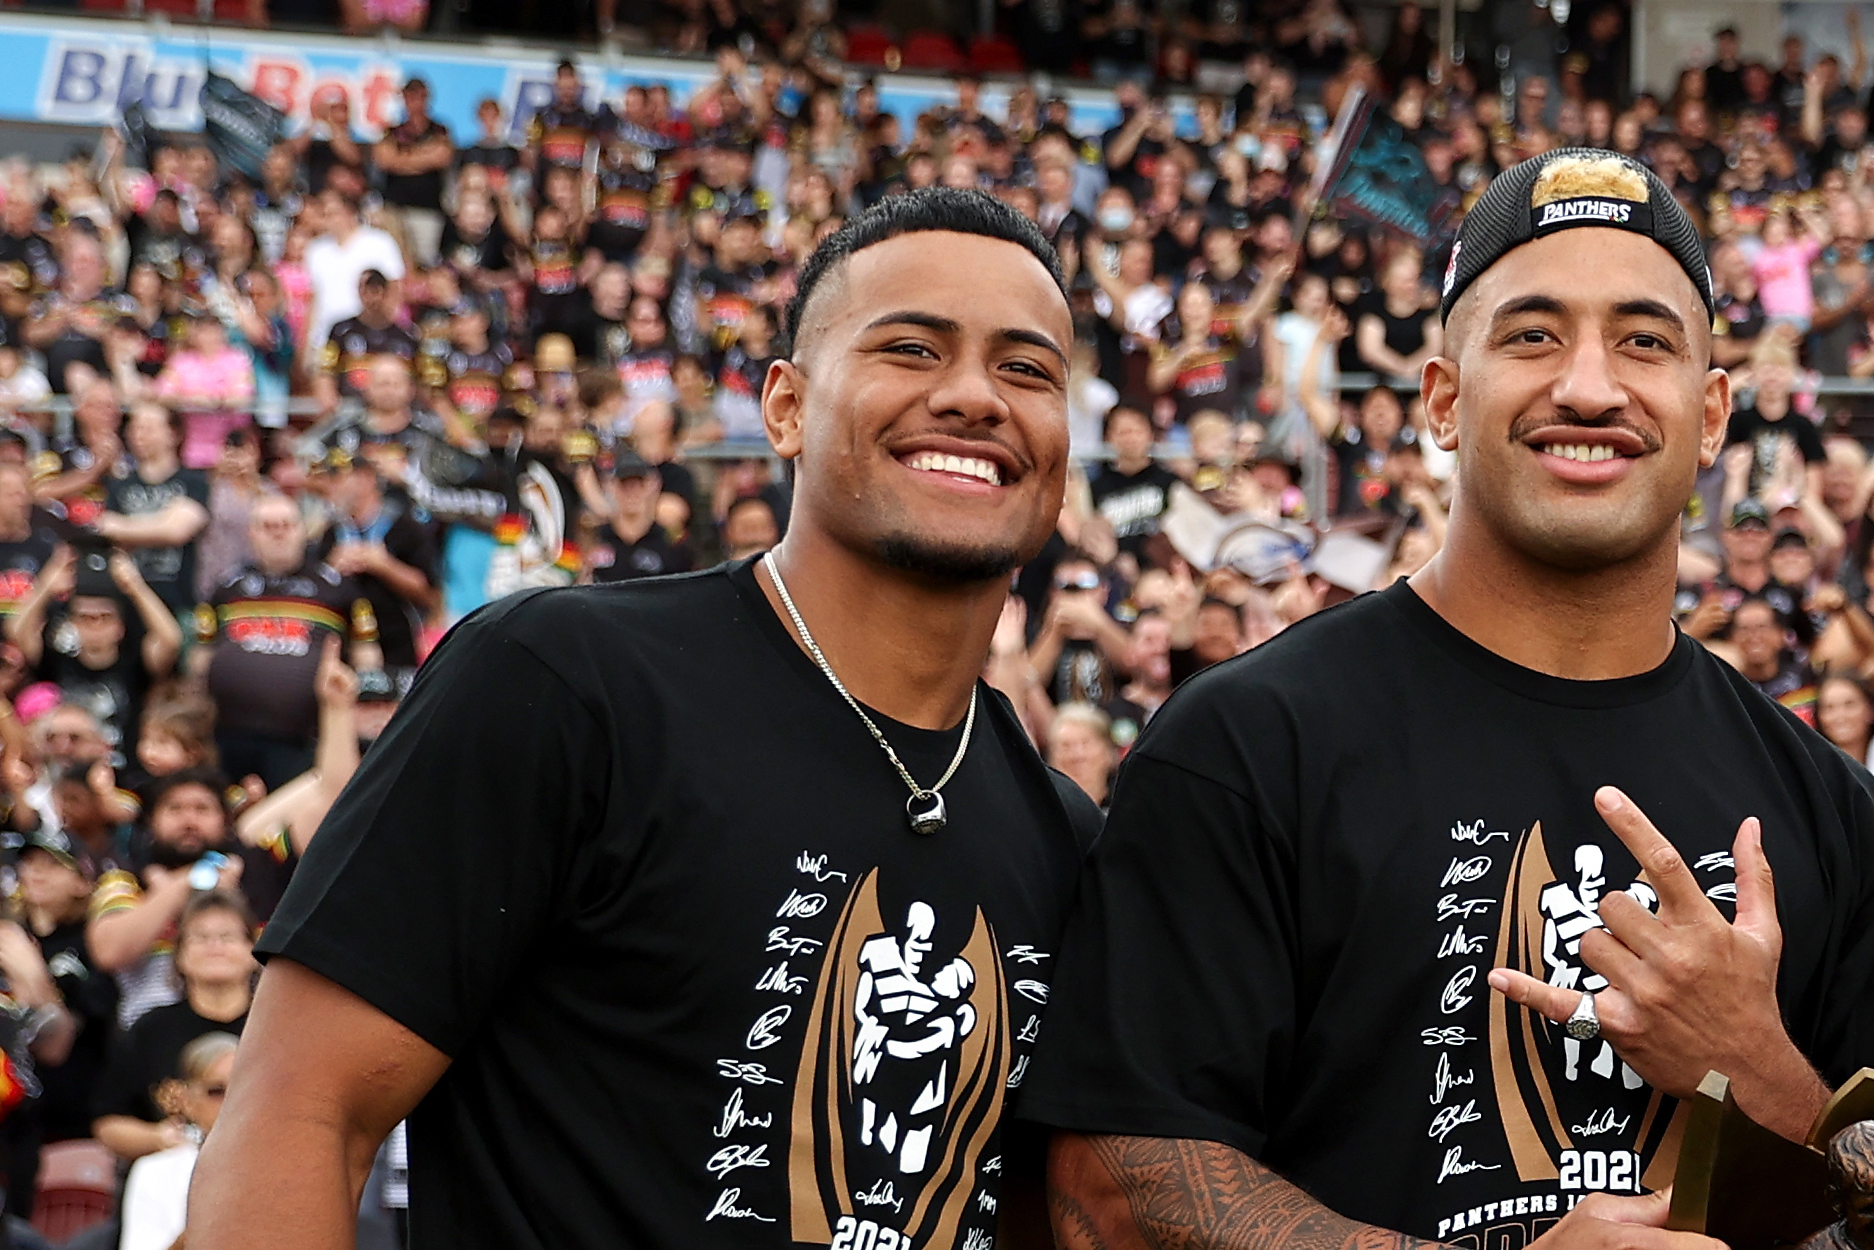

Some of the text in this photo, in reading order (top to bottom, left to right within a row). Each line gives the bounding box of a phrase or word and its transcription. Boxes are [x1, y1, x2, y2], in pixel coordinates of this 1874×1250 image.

[1542, 201, 1631, 222] PANTHERS
[1559, 1151, 1642, 1193] 2021
[1438, 1195, 1557, 1239] PANTHERS
